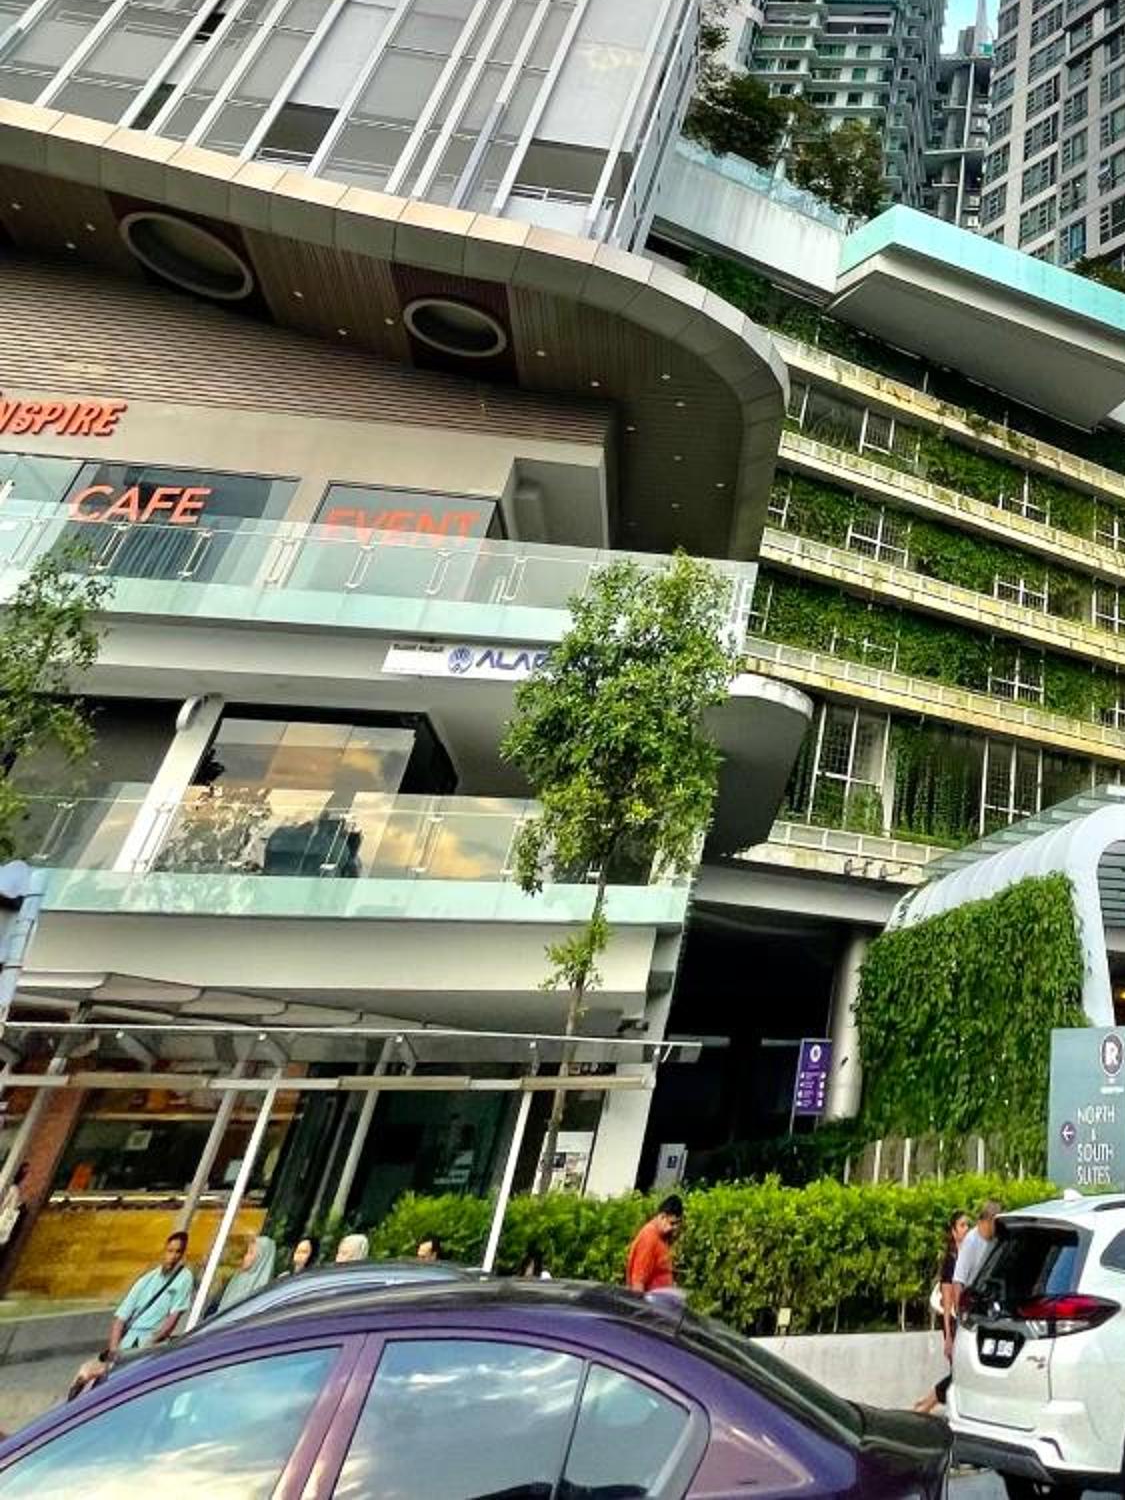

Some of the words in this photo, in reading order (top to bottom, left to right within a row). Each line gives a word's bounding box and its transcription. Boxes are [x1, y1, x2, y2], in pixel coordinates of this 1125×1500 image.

[67, 483, 212, 524] CAFE
[326, 507, 481, 548] EVENT
[1077, 1104, 1115, 1125] NORTH
[1076, 1143, 1115, 1163] SOUTH
[1076, 1165, 1111, 1186] SUITES
